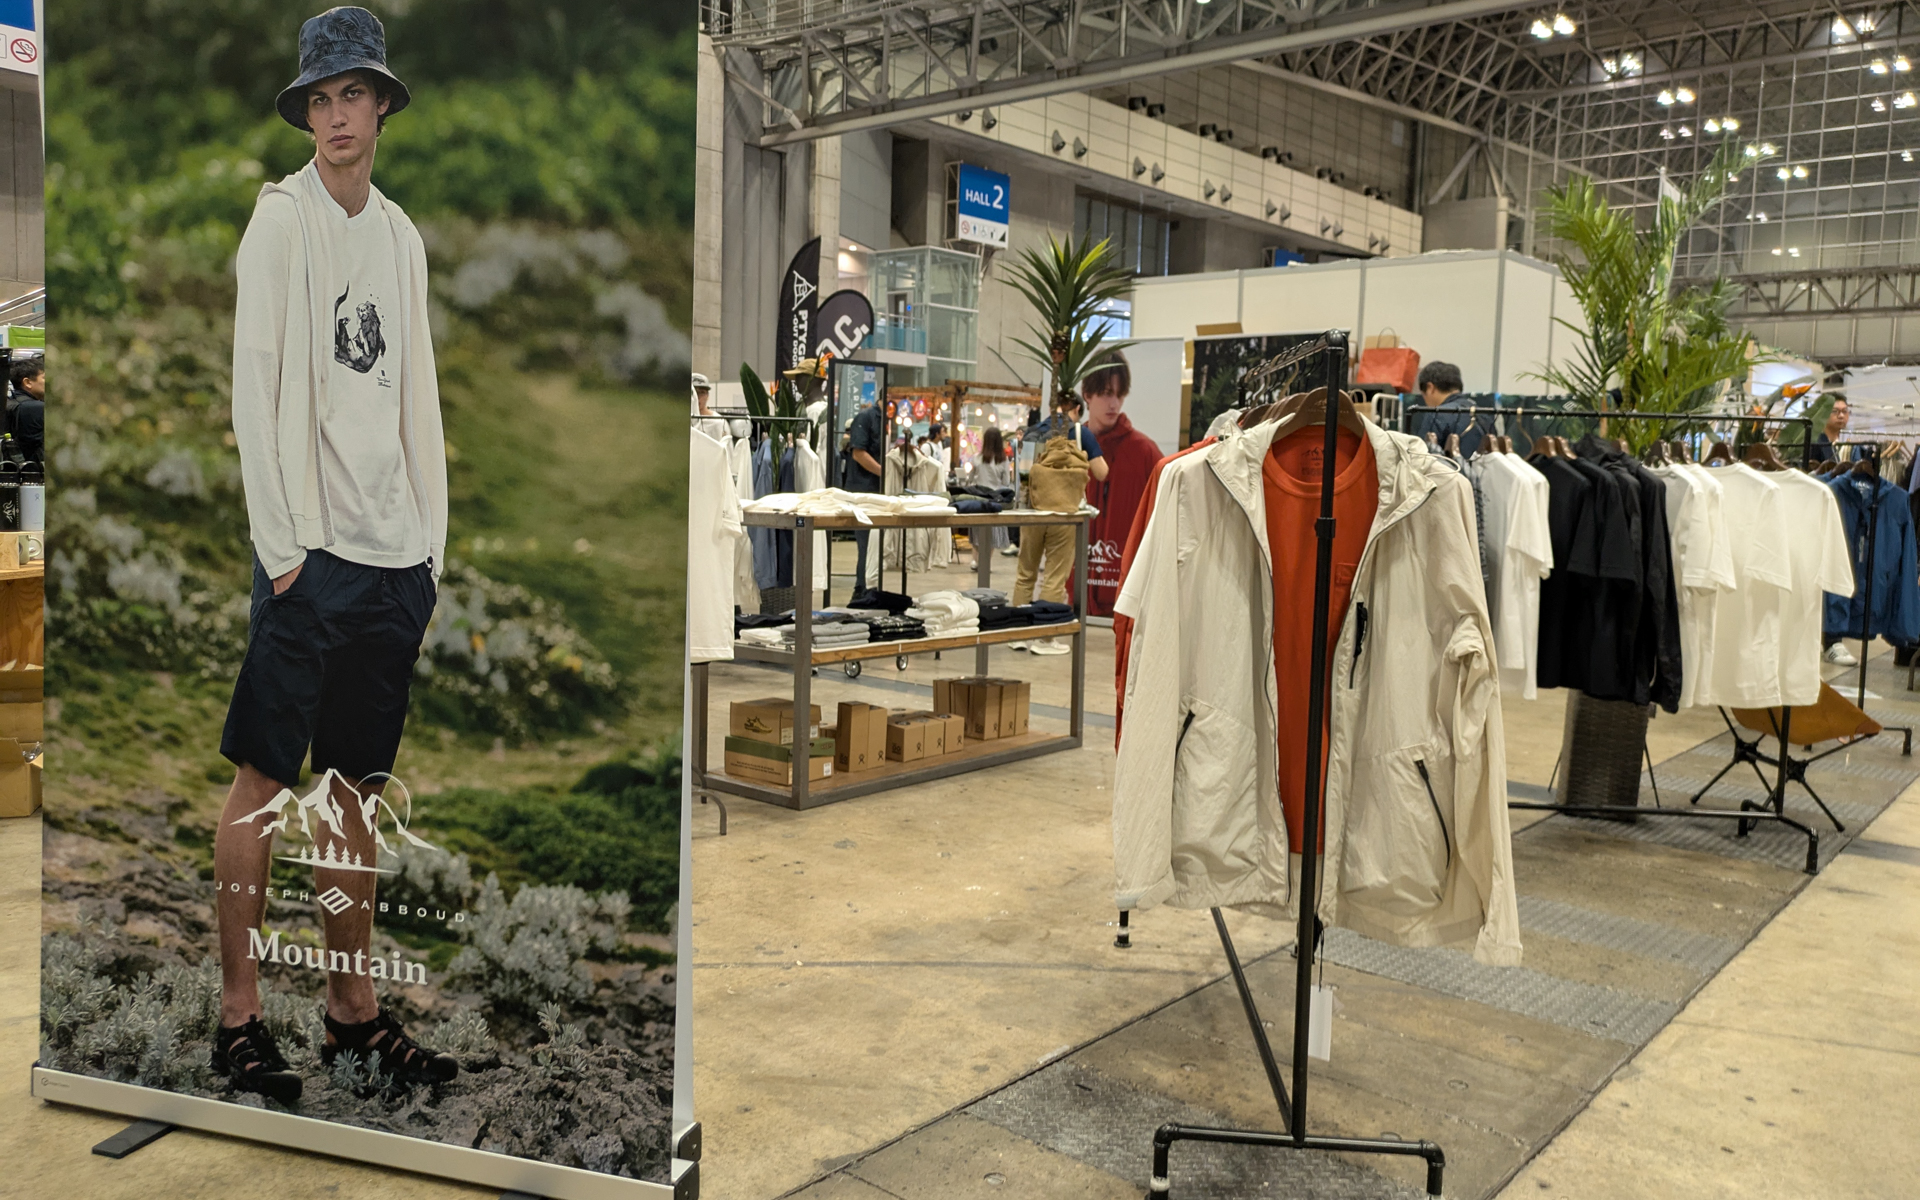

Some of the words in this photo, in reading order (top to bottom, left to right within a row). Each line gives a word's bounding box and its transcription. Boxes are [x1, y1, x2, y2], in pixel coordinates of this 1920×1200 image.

[965, 188, 991, 207] HALL
[992, 184, 1004, 210] 2
[1087, 578, 1119, 587] ountain
[215, 881, 309, 902] JOSEPH
[360, 900, 465, 923] ABBOUD
[246, 927, 428, 985] Mountain
